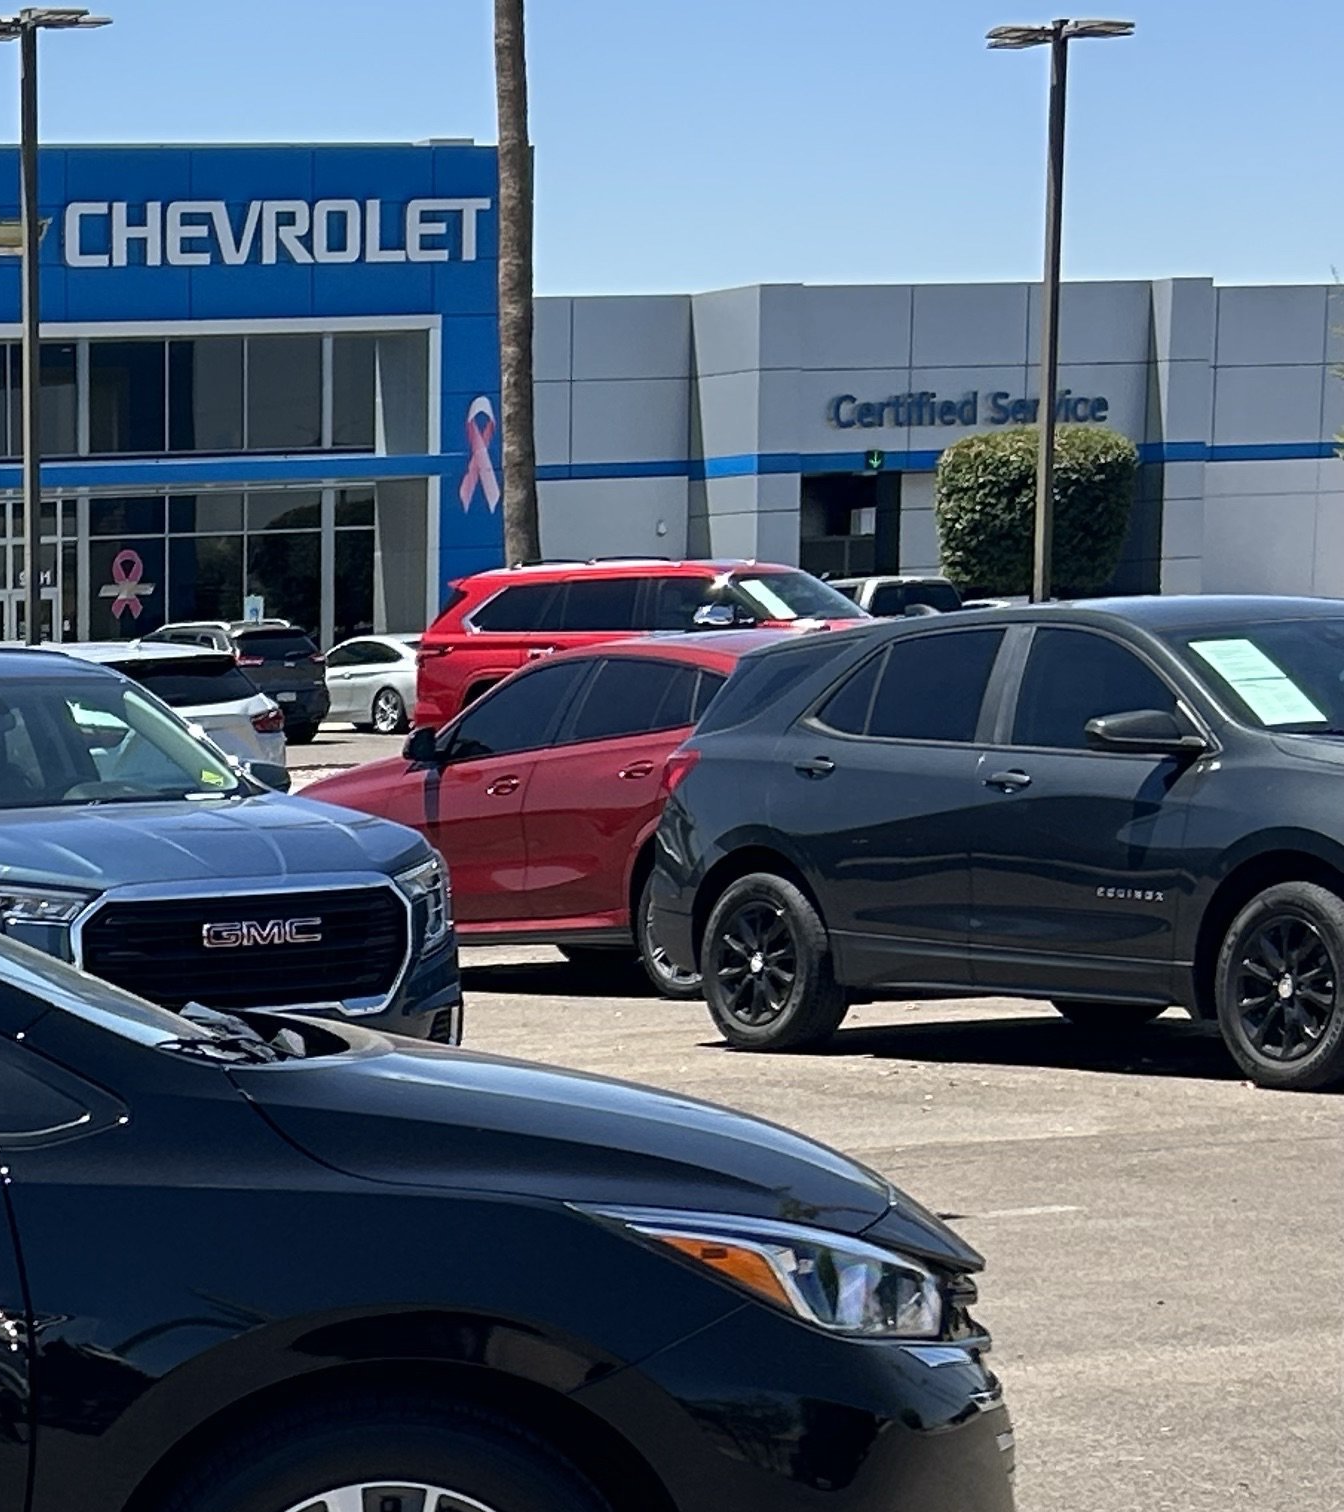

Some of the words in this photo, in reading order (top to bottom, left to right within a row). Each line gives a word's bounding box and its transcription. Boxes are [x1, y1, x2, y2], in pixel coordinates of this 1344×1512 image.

[65, 198, 491, 267] CHEVROLET
[830, 391, 978, 428] Certified
[987, 388, 1109, 425] Serice
[202, 917, 322, 948] GMC
